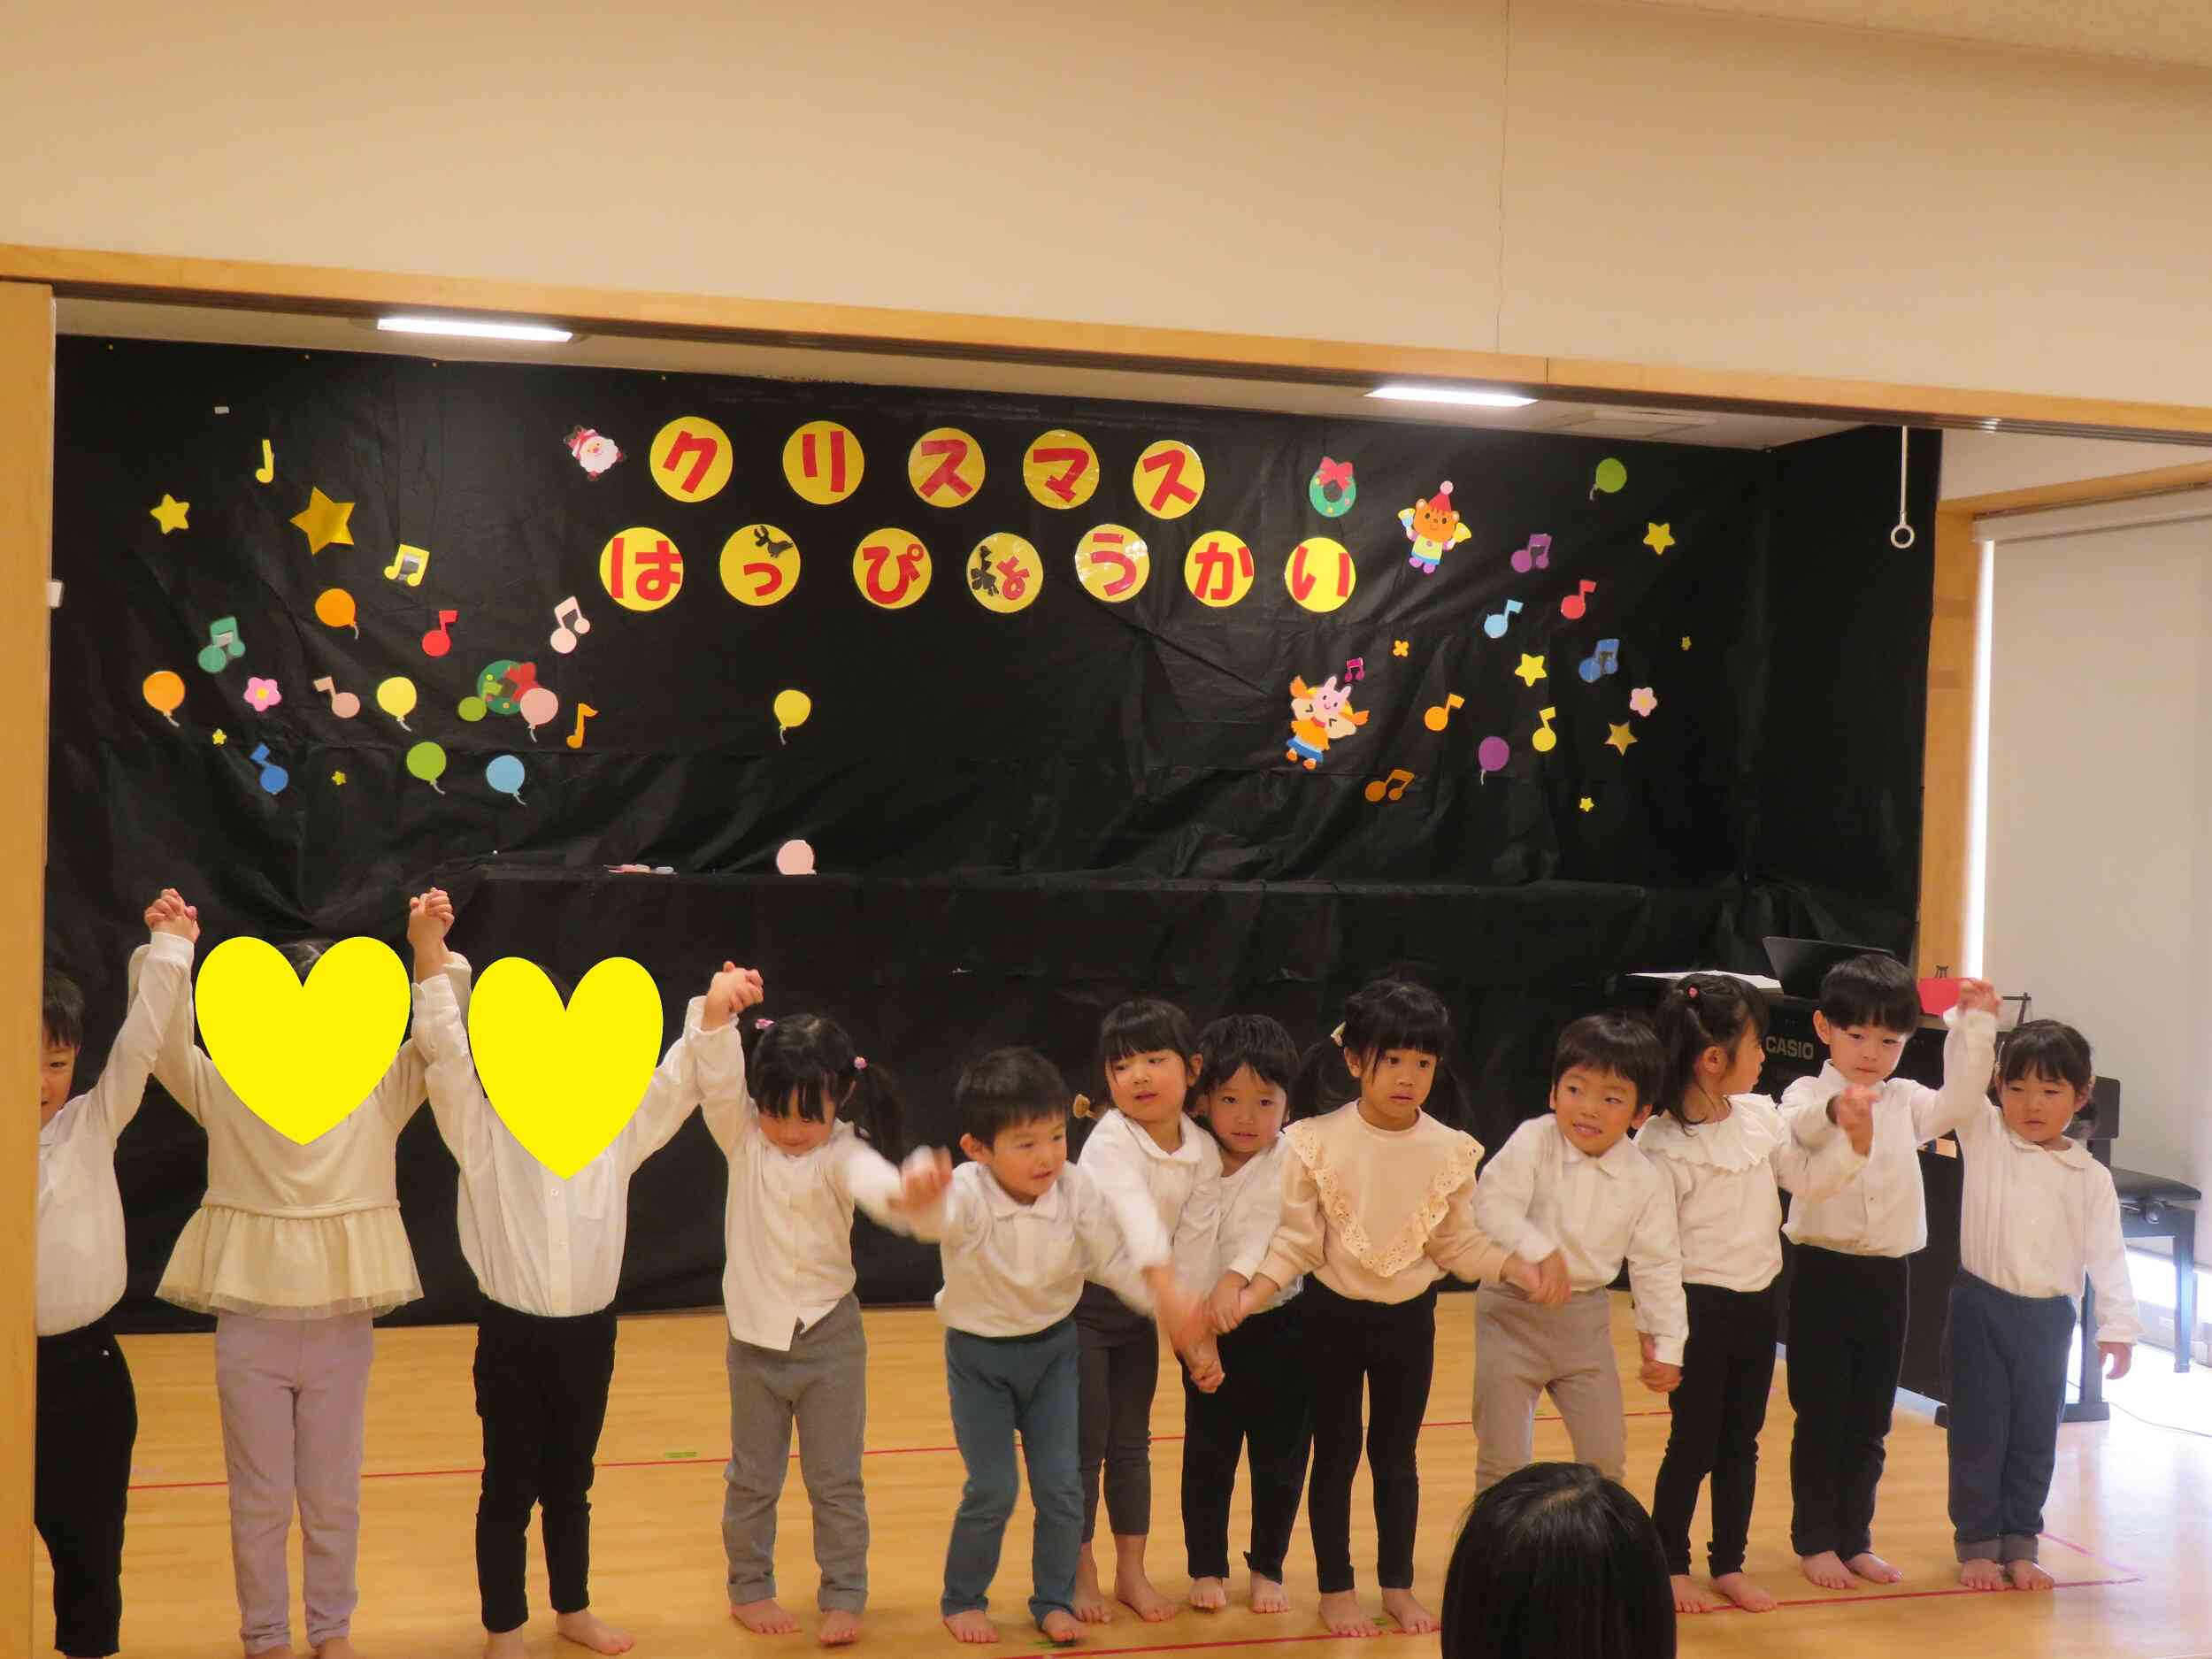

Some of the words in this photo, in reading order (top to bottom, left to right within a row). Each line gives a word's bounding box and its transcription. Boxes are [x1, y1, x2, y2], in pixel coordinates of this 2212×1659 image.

[663, 430, 1199, 511] クリスマス
[611, 533, 1349, 604] はっぴょうかい
[1765, 1036, 1814, 1060] CASIO
